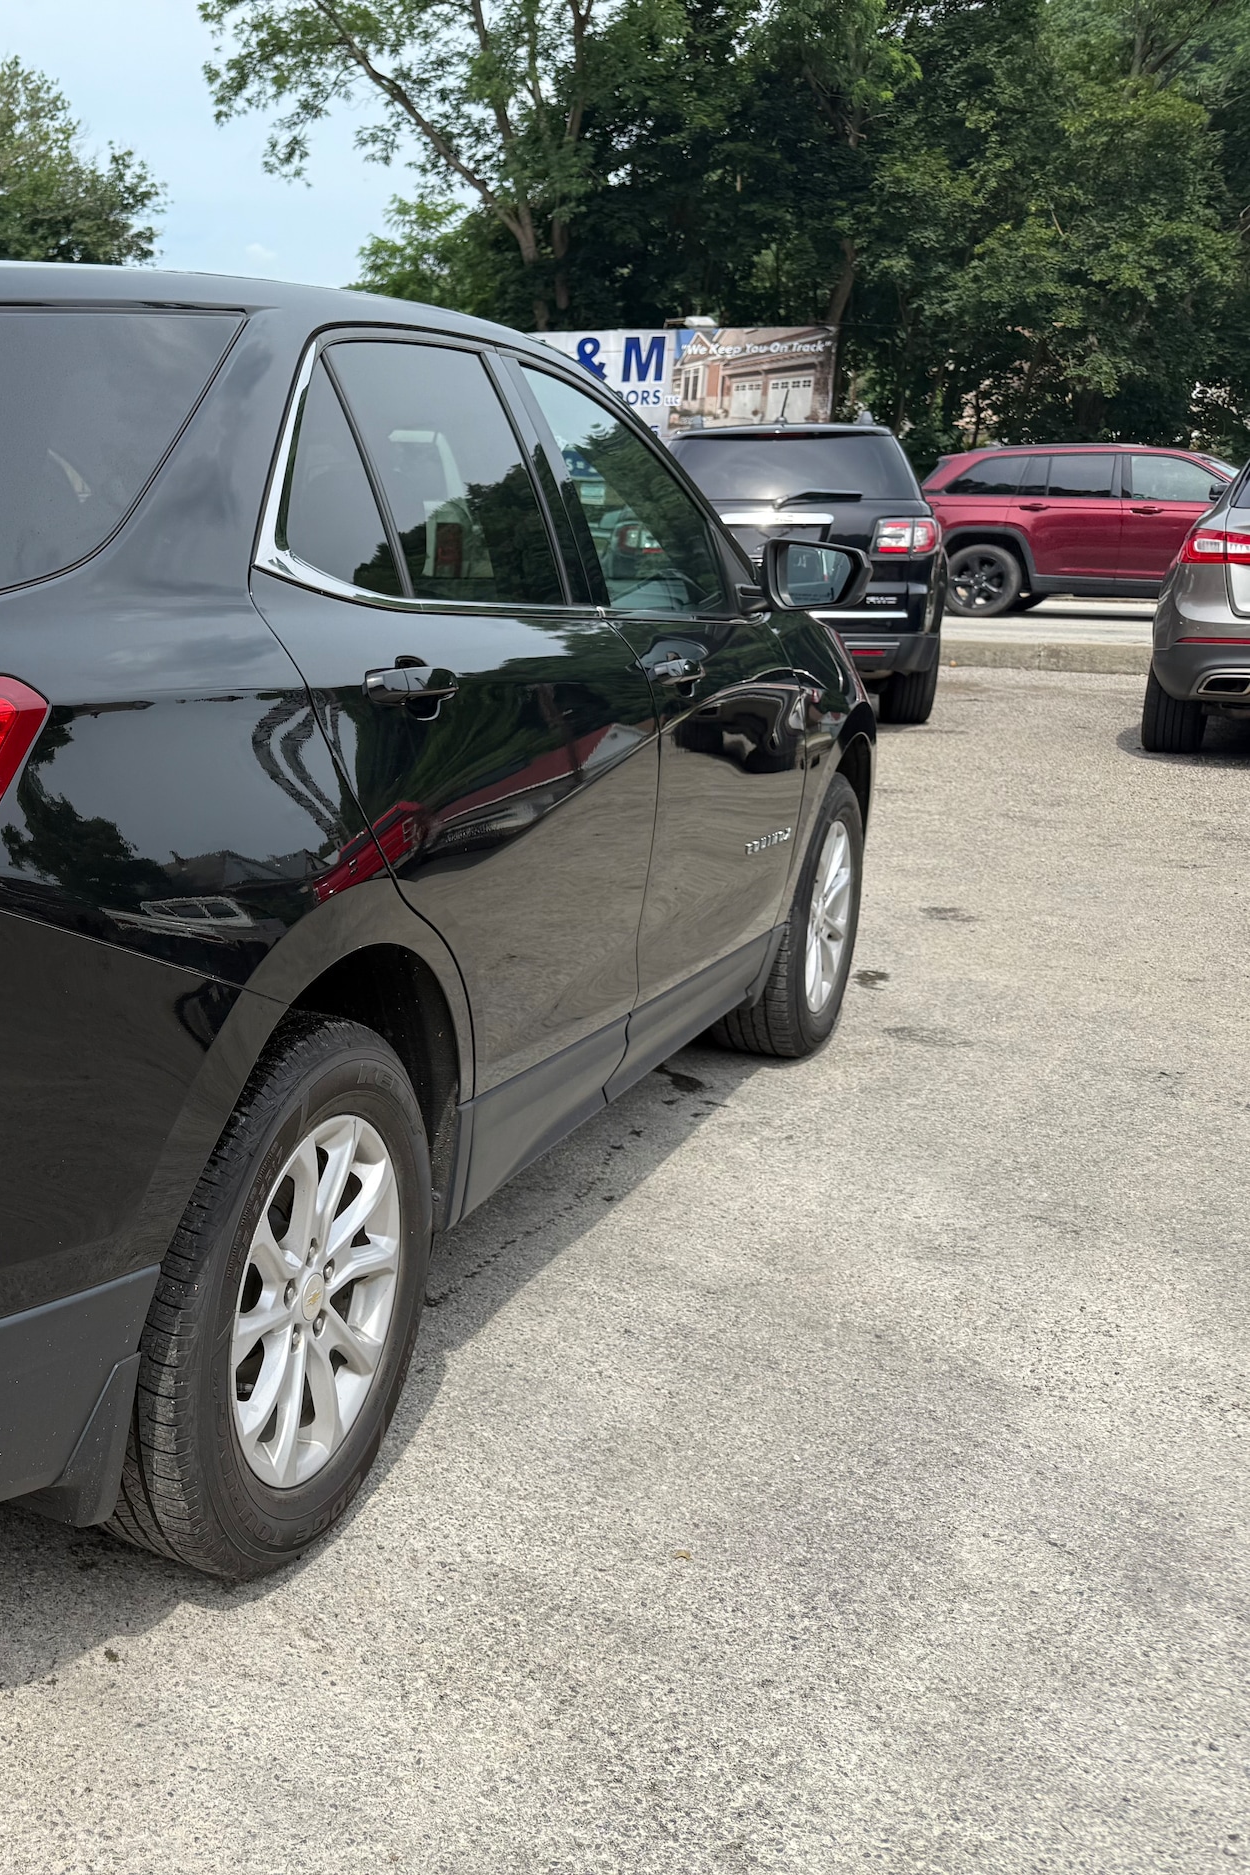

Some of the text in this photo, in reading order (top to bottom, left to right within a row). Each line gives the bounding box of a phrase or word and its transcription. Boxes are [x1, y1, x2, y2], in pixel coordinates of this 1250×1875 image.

[577, 336, 666, 382] & M
[709, 343, 742, 357] Keep
[745, 343, 766, 354] You
[769, 342, 789, 354] On
